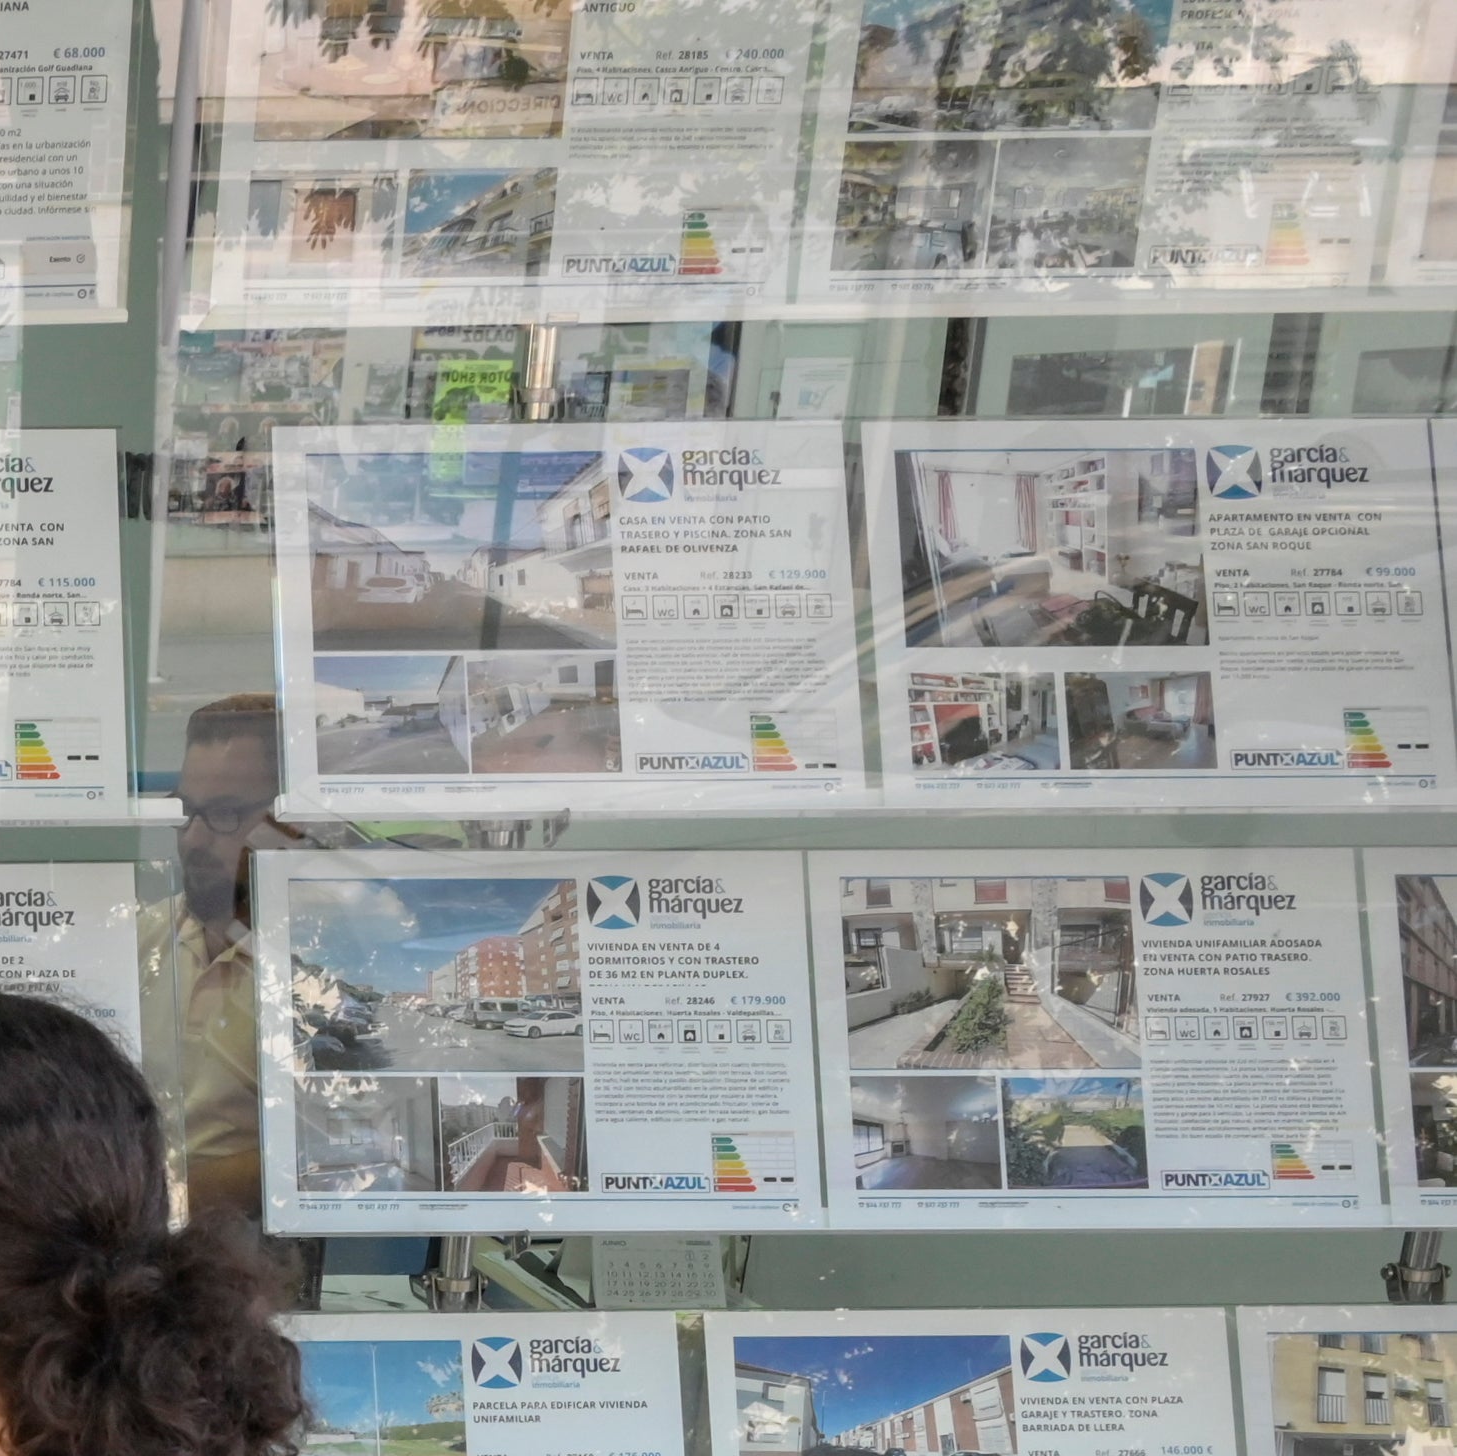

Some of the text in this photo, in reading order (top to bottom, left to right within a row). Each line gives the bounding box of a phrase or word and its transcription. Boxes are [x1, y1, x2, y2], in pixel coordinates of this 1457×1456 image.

[53, 48, 61, 59] €
[64, 47, 105, 58] 68.000
[683, 467, 782, 491] márquez
[1271, 465, 1370, 489] márquez
[620, 544, 739, 554] RAFAEL DE OLIVENZA
[38, 578, 44, 587] €
[49, 577, 96, 587] 115.000
[649, 895, 744, 920] márquez
[1201, 892, 1297, 916] márquez
[1143, 966, 1271, 976] ZONA HUERTA ROSALES
[686, 995, 786, 1006] 28246 € 179.900
[530, 1355, 621, 1379] márquez
[1078, 1350, 1169, 1373] márquez
[472, 1400, 648, 1410] PARCELA PARA EDIFICAR VIVIENDA
[473, 1414, 541, 1424] UNIFAMILIAR
[1022, 1423, 1125, 1432] BARRIADA DE LLERA
